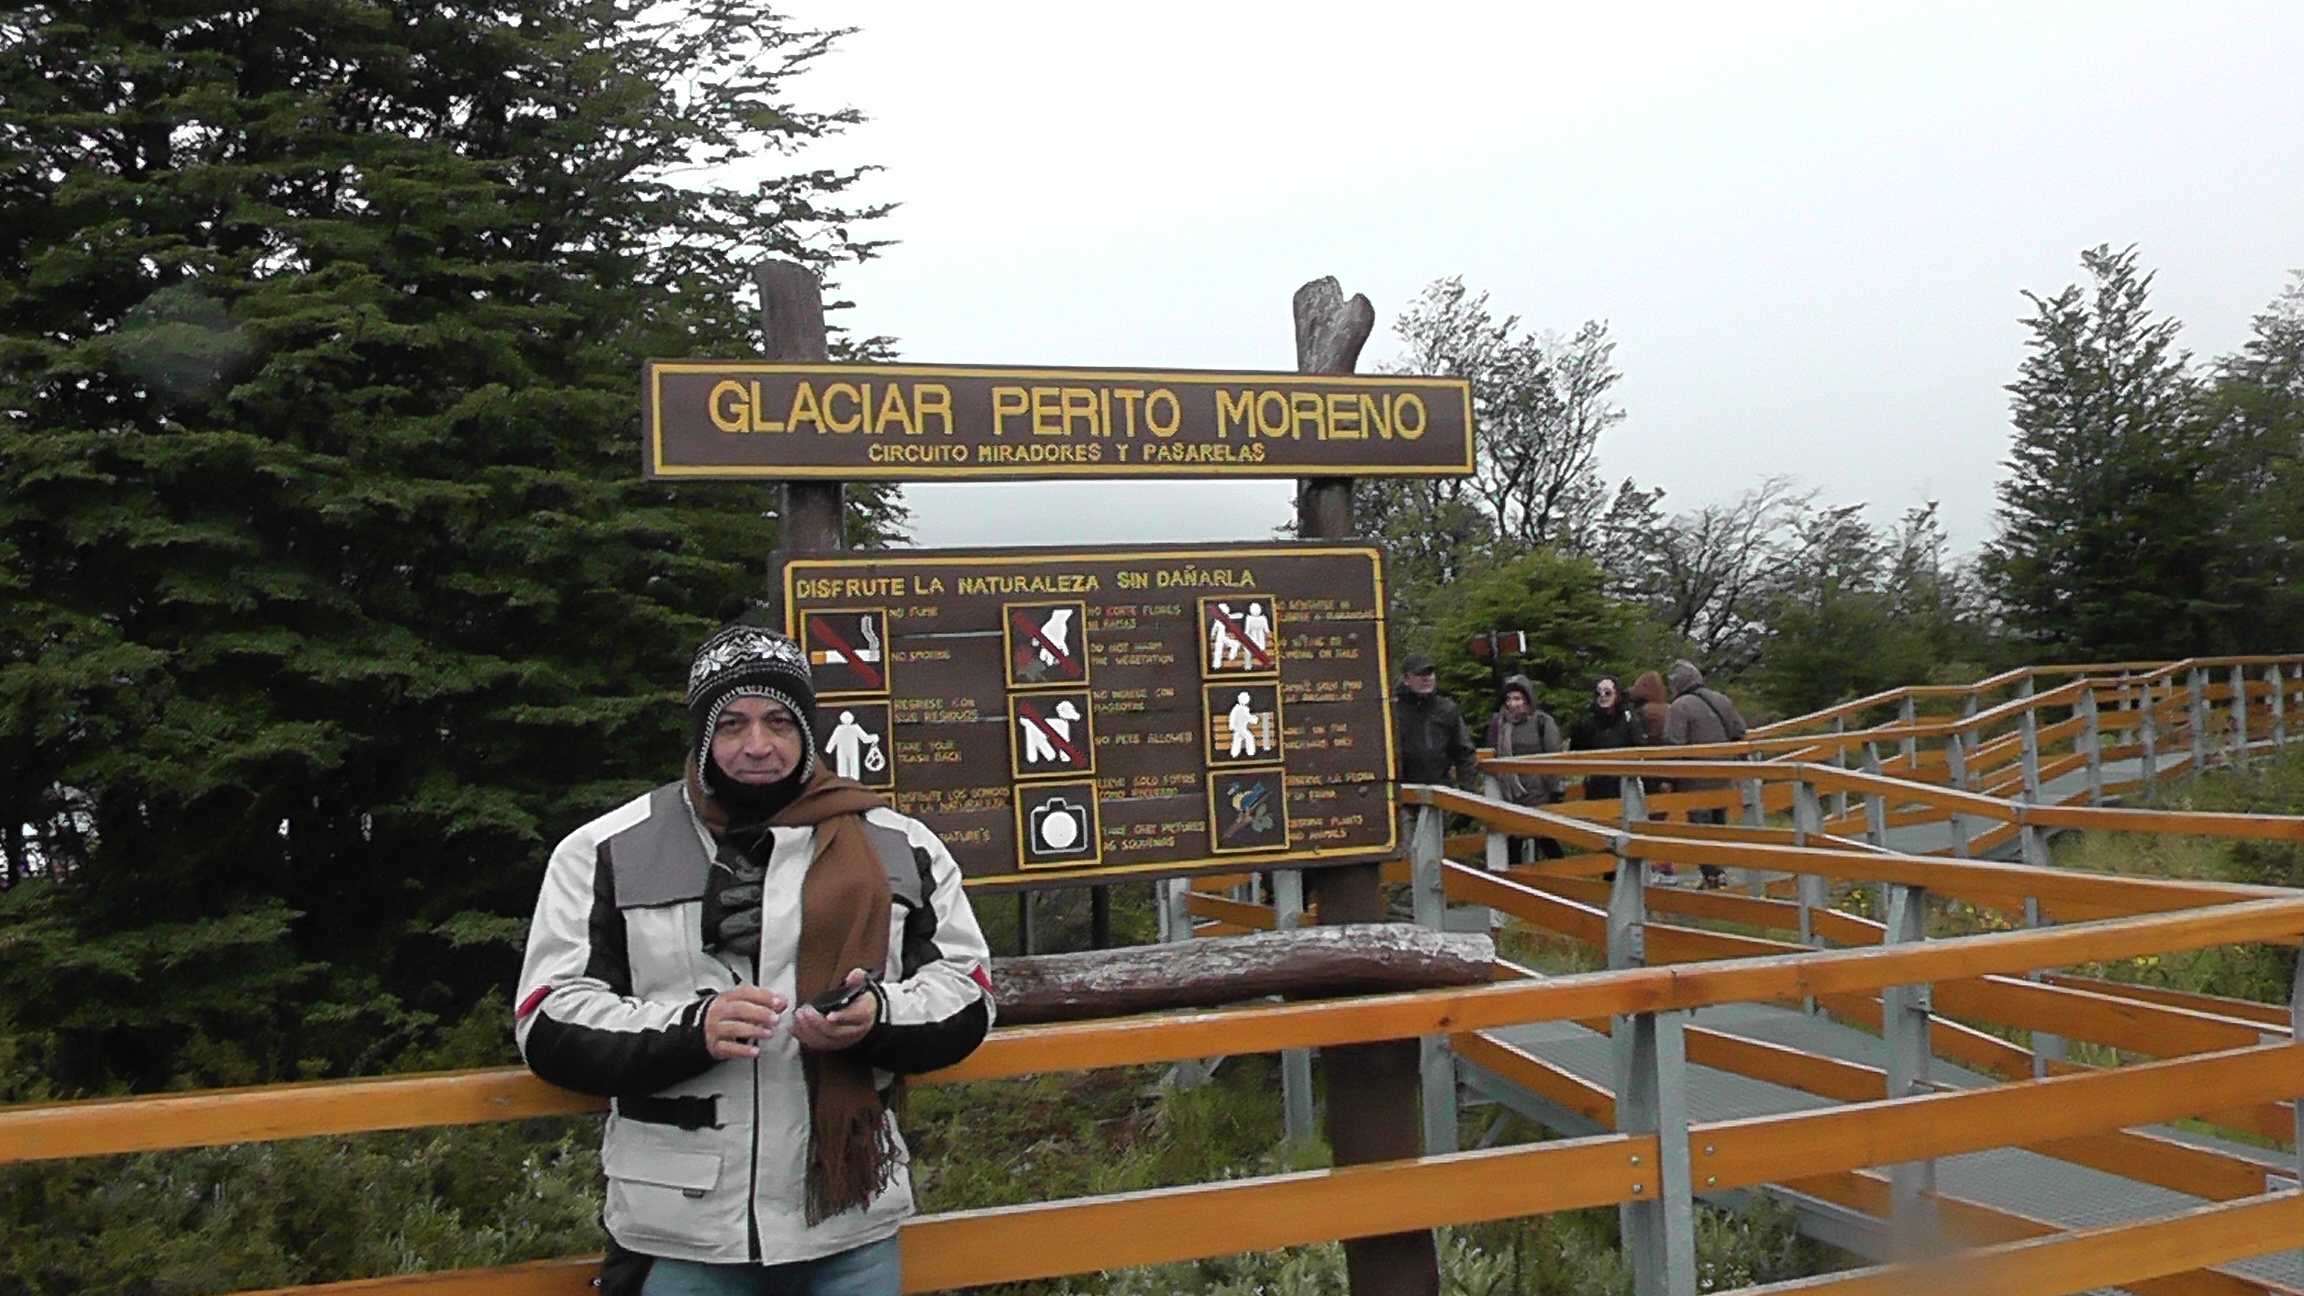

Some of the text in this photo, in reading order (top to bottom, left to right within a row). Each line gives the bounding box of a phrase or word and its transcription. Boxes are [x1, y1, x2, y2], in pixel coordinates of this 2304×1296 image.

[709, 379, 1427, 442] GLACIAR PERITO MORENO
[868, 443, 1266, 463] CIRCUITO MIRADORES Y PASARELAS
[796, 564, 1256, 599] DISFRUTE LA NATURALEZA SIN DAÑARLA
